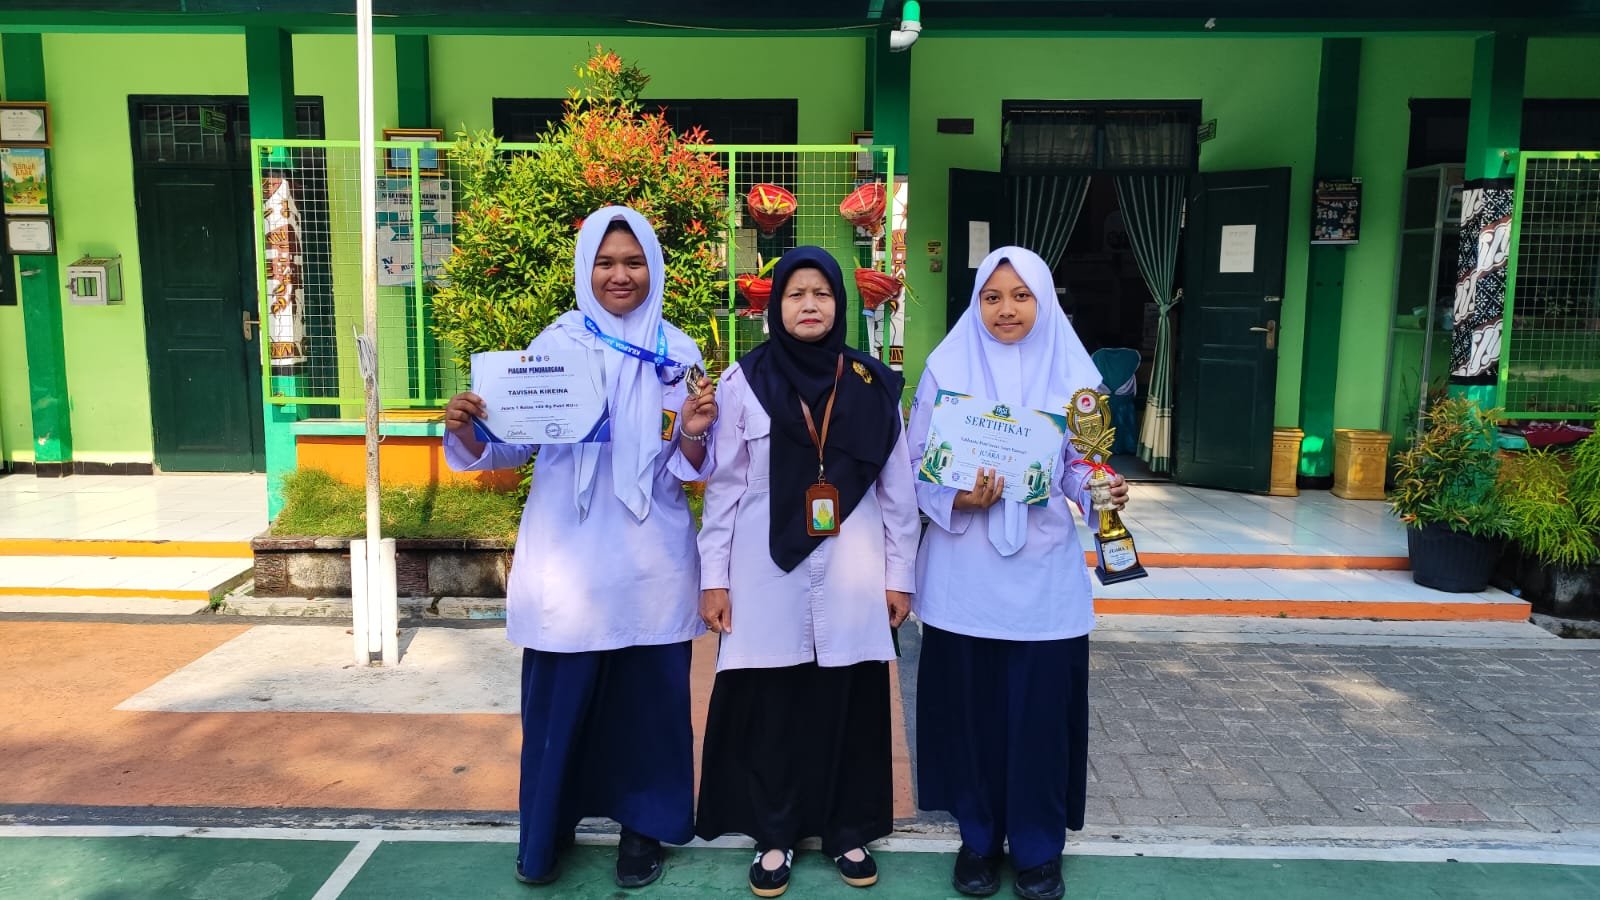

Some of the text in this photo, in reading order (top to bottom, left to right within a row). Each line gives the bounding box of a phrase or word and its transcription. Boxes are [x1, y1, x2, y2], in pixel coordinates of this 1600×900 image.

[508, 367, 528, 375] PIAGAM
[965, 415, 1032, 437] SERTIFIKAT
[979, 449, 1000, 460] JUARA
